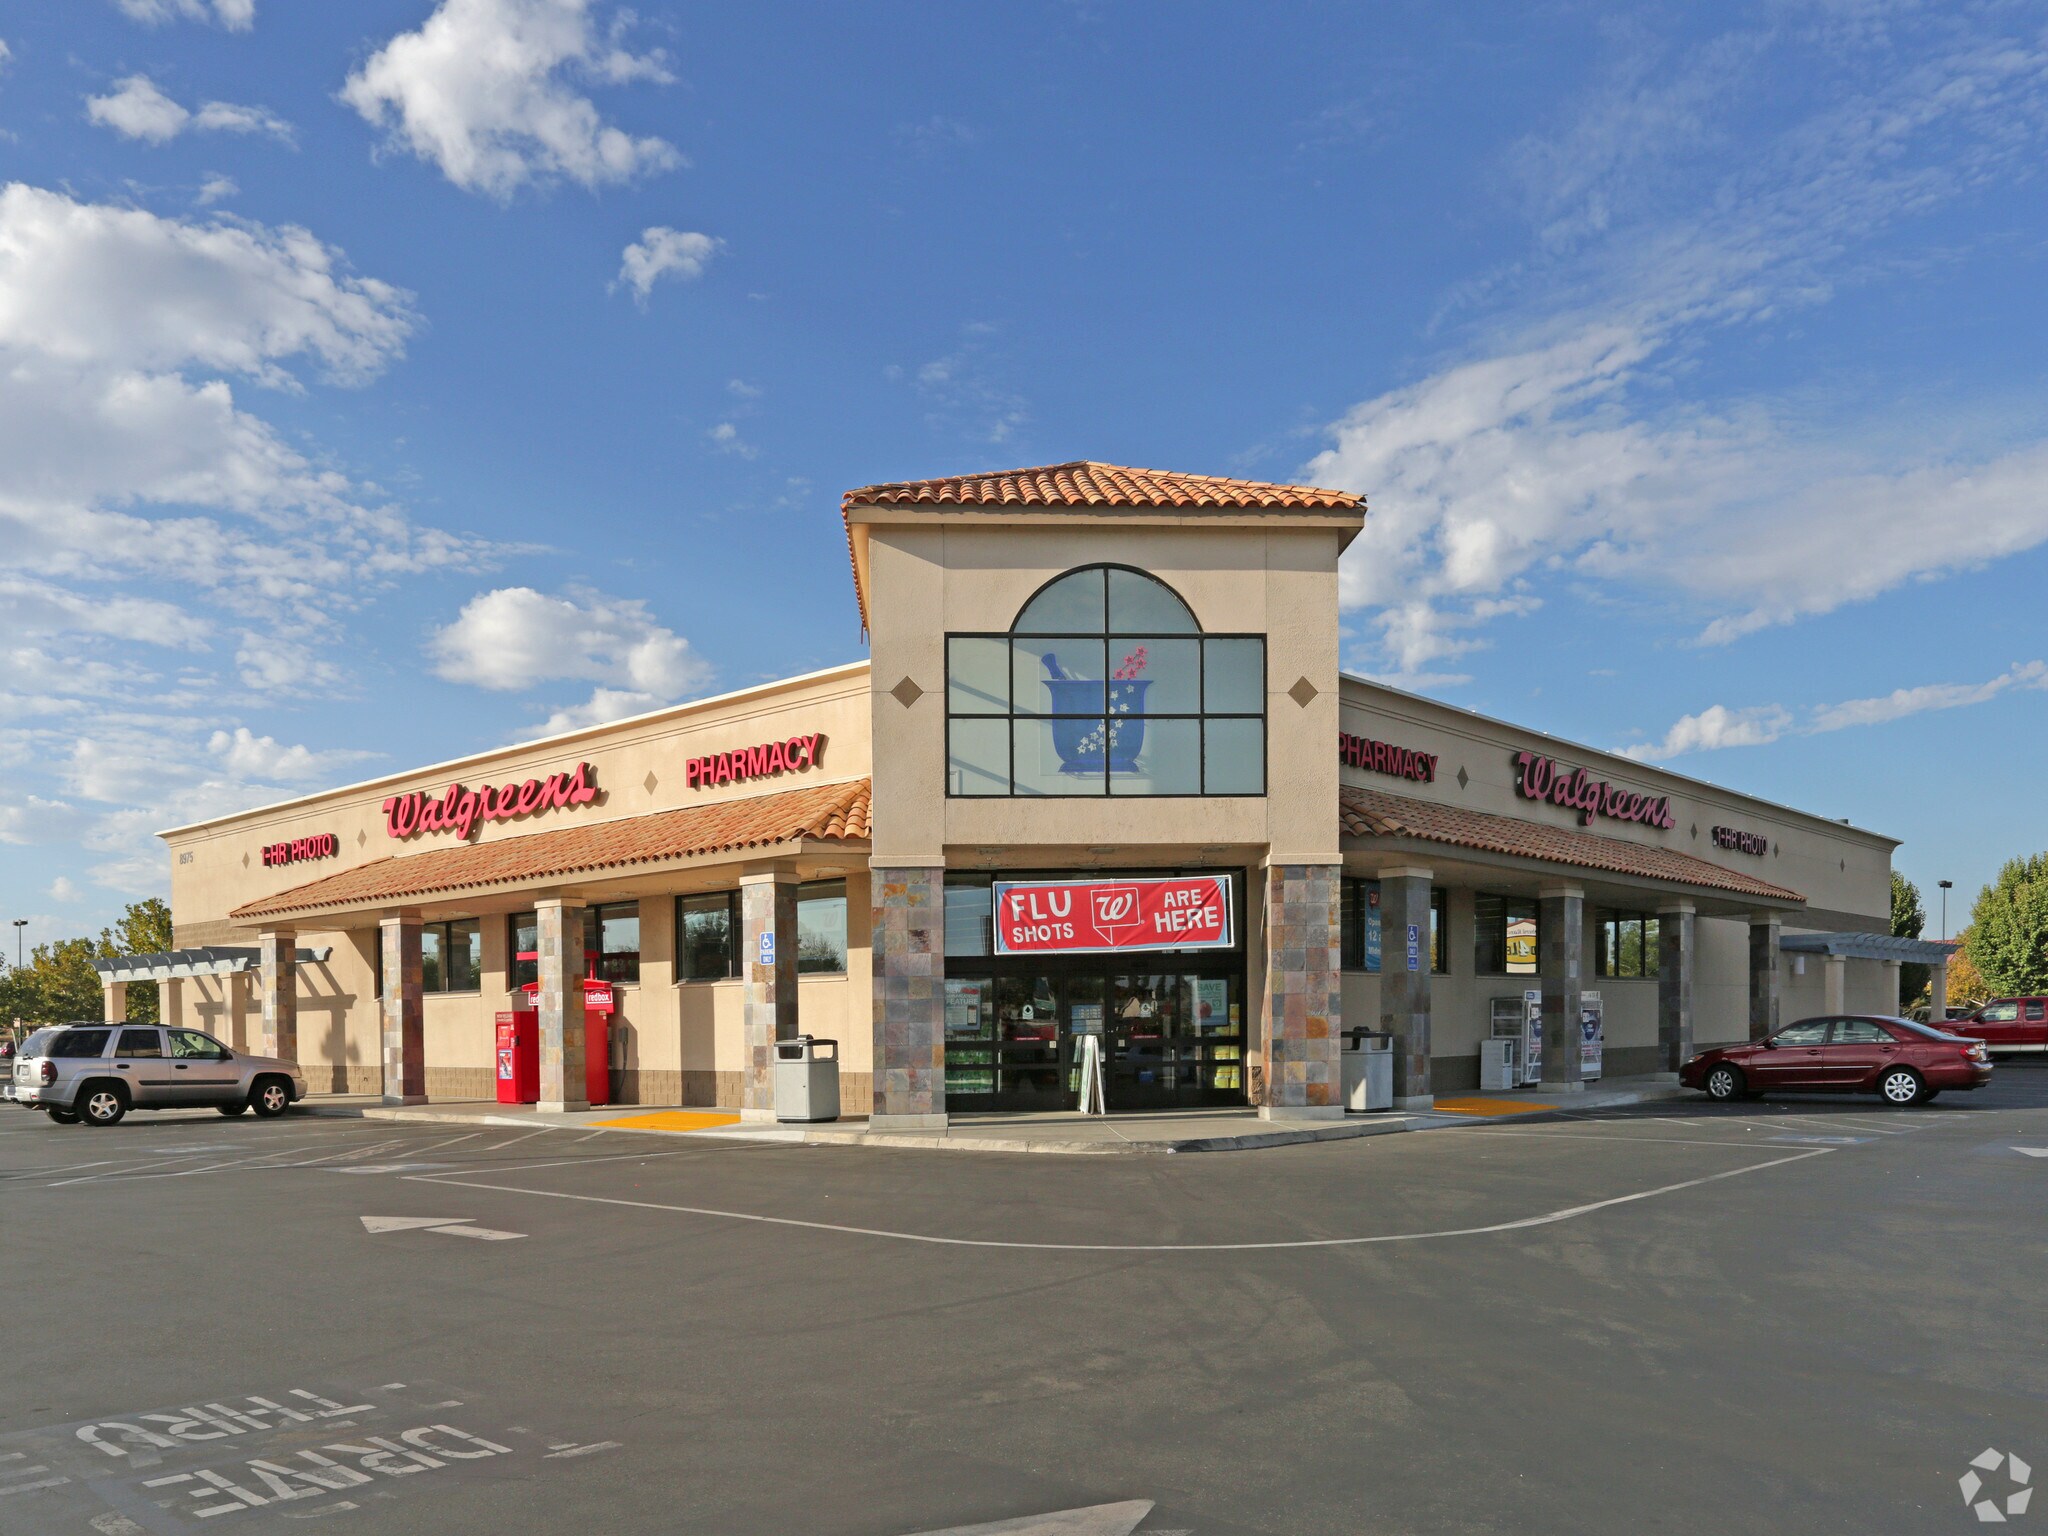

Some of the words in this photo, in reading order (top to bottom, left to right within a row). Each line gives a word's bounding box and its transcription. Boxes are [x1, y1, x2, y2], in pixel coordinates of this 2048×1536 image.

[686, 733, 821, 788] PHARMACY
[382, 762, 597, 840] Walgreens
[1518, 751, 1676, 830] Walgreens
[260, 842, 287, 866] 1-HR
[291, 832, 333, 862] PHOTO
[1717, 826, 1737, 850] 1-HR
[1740, 832, 1768, 856] PHOTO
[179, 851, 194, 865] 8975
[1011, 890, 1072, 922] FLU
[1164, 888, 1202, 908] ARE
[1012, 922, 1075, 944] SHOTS
[1154, 905, 1220, 934] HERE
[588, 991, 610, 1002] redbox
[142, 1424, 514, 1518] DRIVE
